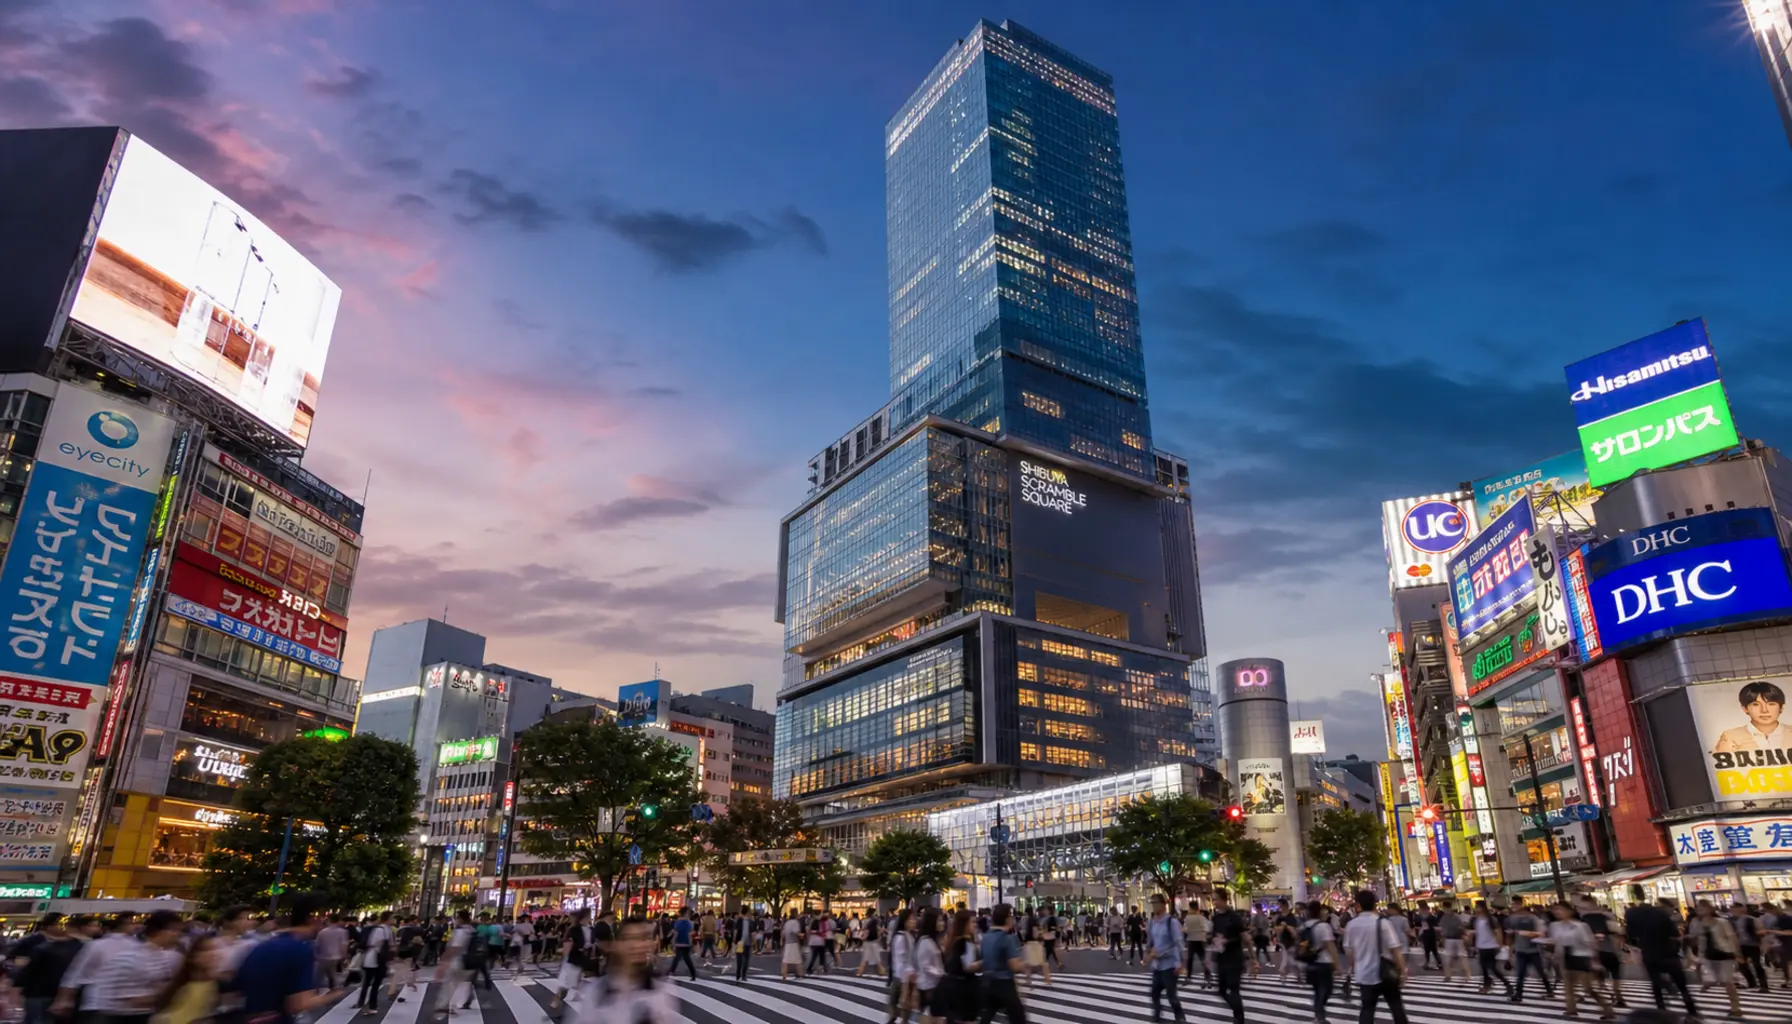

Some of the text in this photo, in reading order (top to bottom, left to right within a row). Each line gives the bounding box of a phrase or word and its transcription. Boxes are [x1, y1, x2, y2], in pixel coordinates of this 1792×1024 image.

[1571, 345, 1707, 402] Hisamitsu
[1590, 405, 1721, 463] サロンパス
[59, 442, 150, 478] eyecity
[1020, 460, 1069, 488] SHIBUYA
[1021, 475, 1087, 507] SCRAMBLE
[1022, 488, 1073, 515] SQUARE
[1408, 511, 1464, 540] UC
[1631, 525, 1691, 556] DHC
[1611, 559, 1737, 625] DHC
